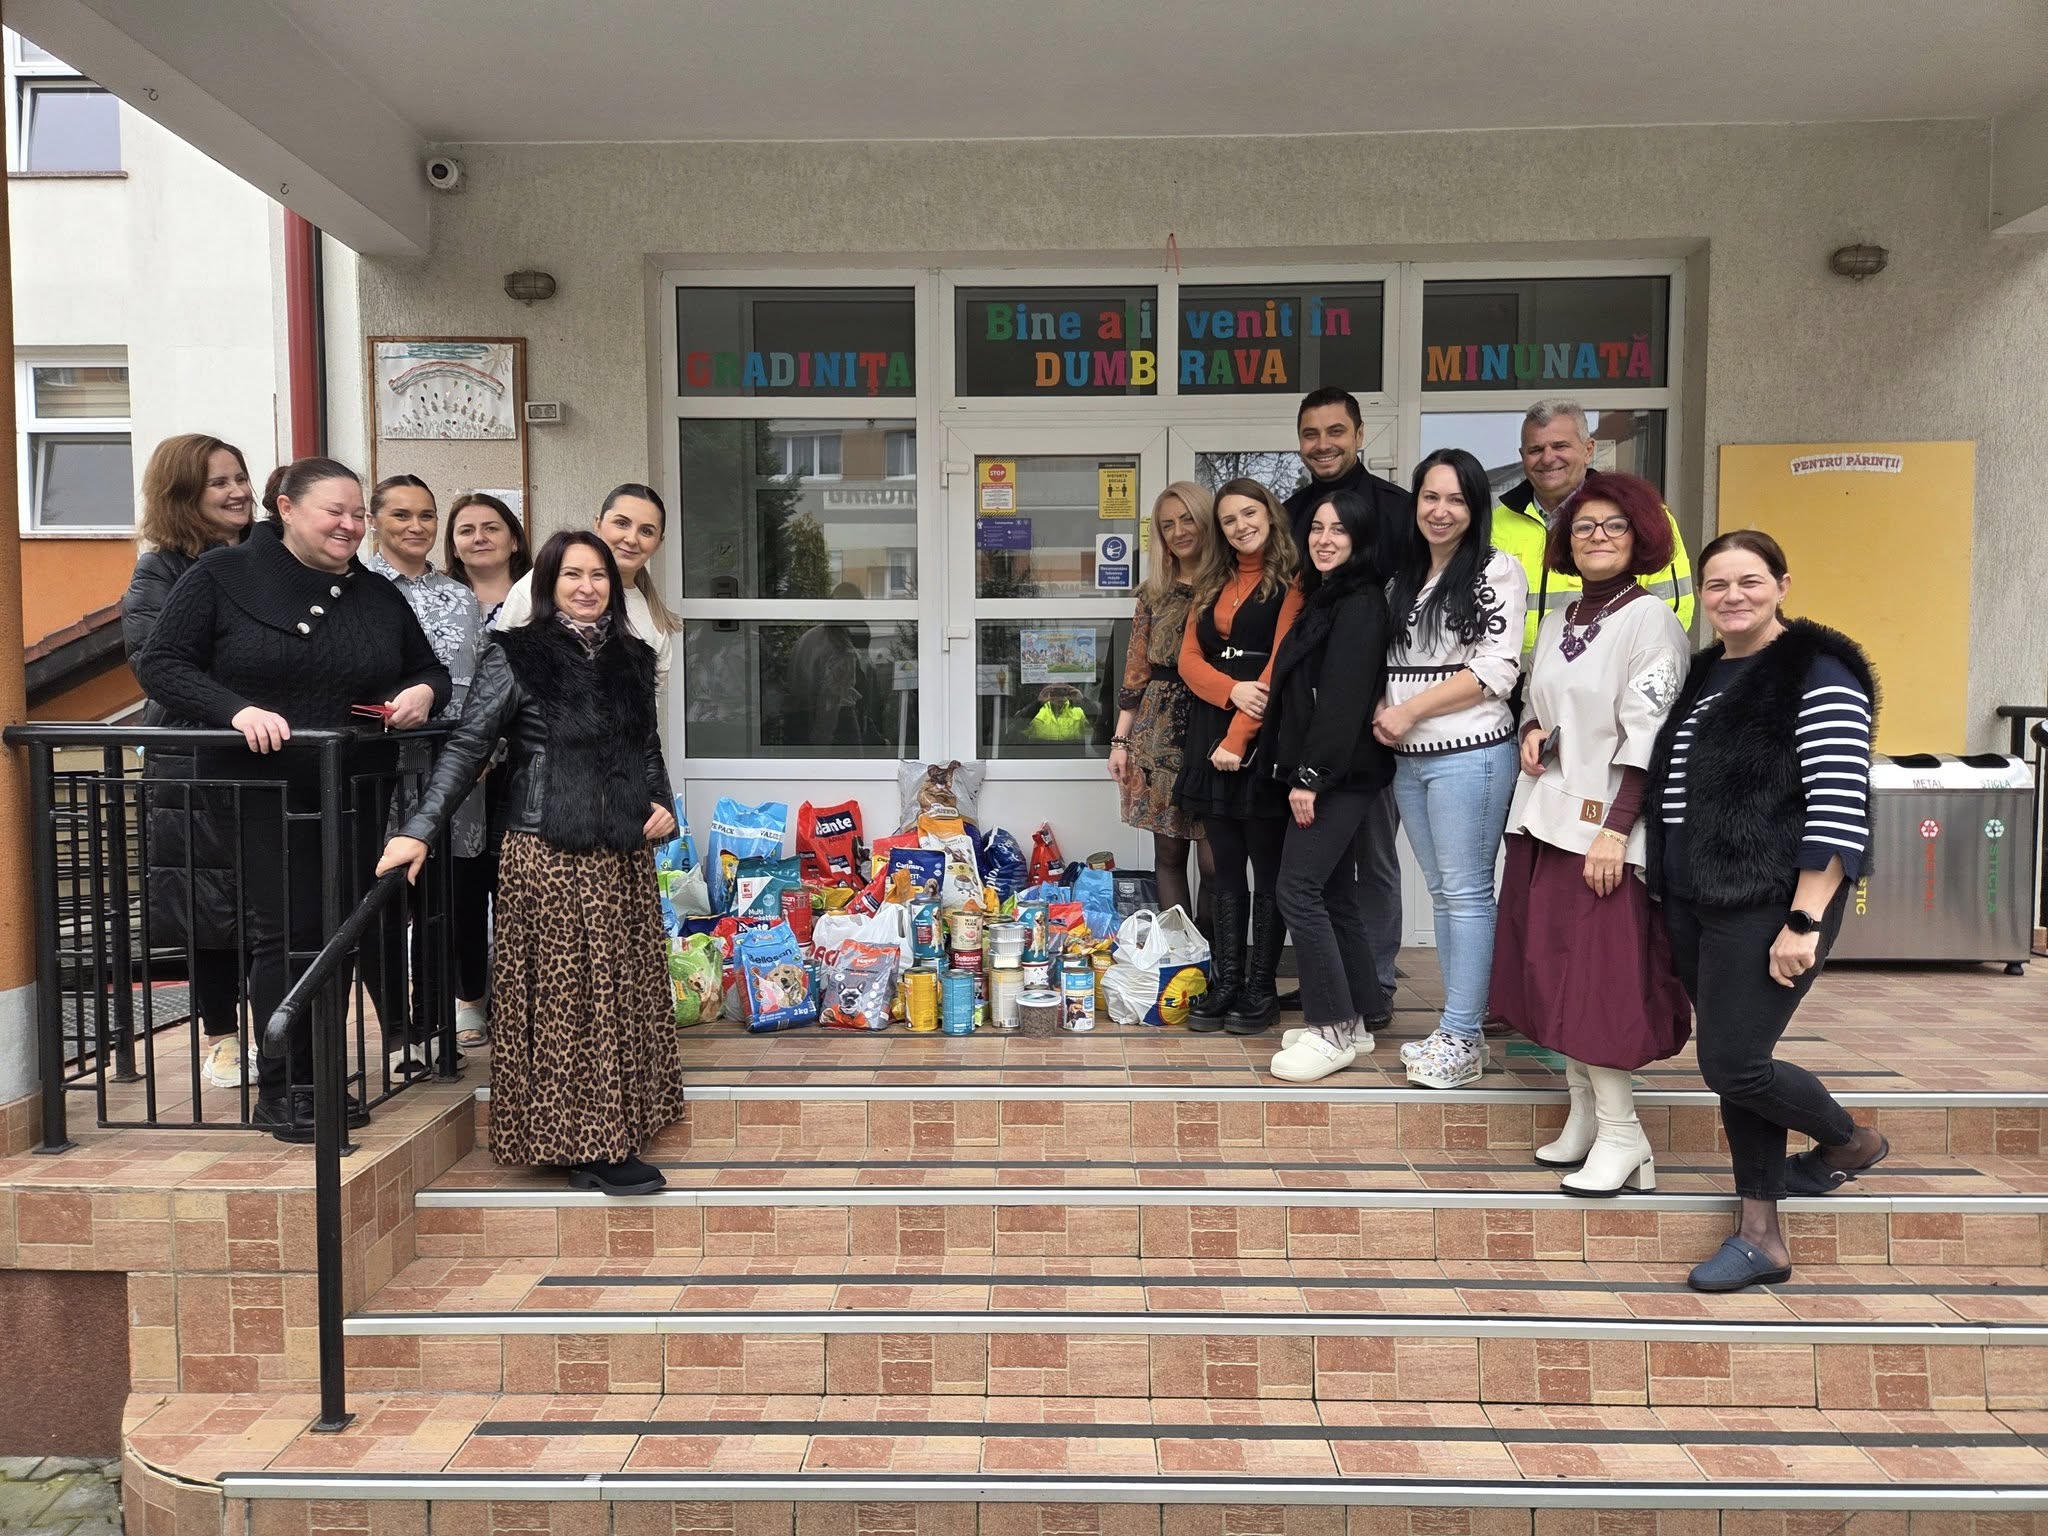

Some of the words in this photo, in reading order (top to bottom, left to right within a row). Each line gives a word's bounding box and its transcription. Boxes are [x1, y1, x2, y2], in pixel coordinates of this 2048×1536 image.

[986, 303, 1081, 341] Bine
[1185, 300, 1292, 339] venit
[1792, 457, 1843, 473] PENTRU
[1913, 779, 1944, 789] METAL
[1856, 875, 1868, 916] STIC
